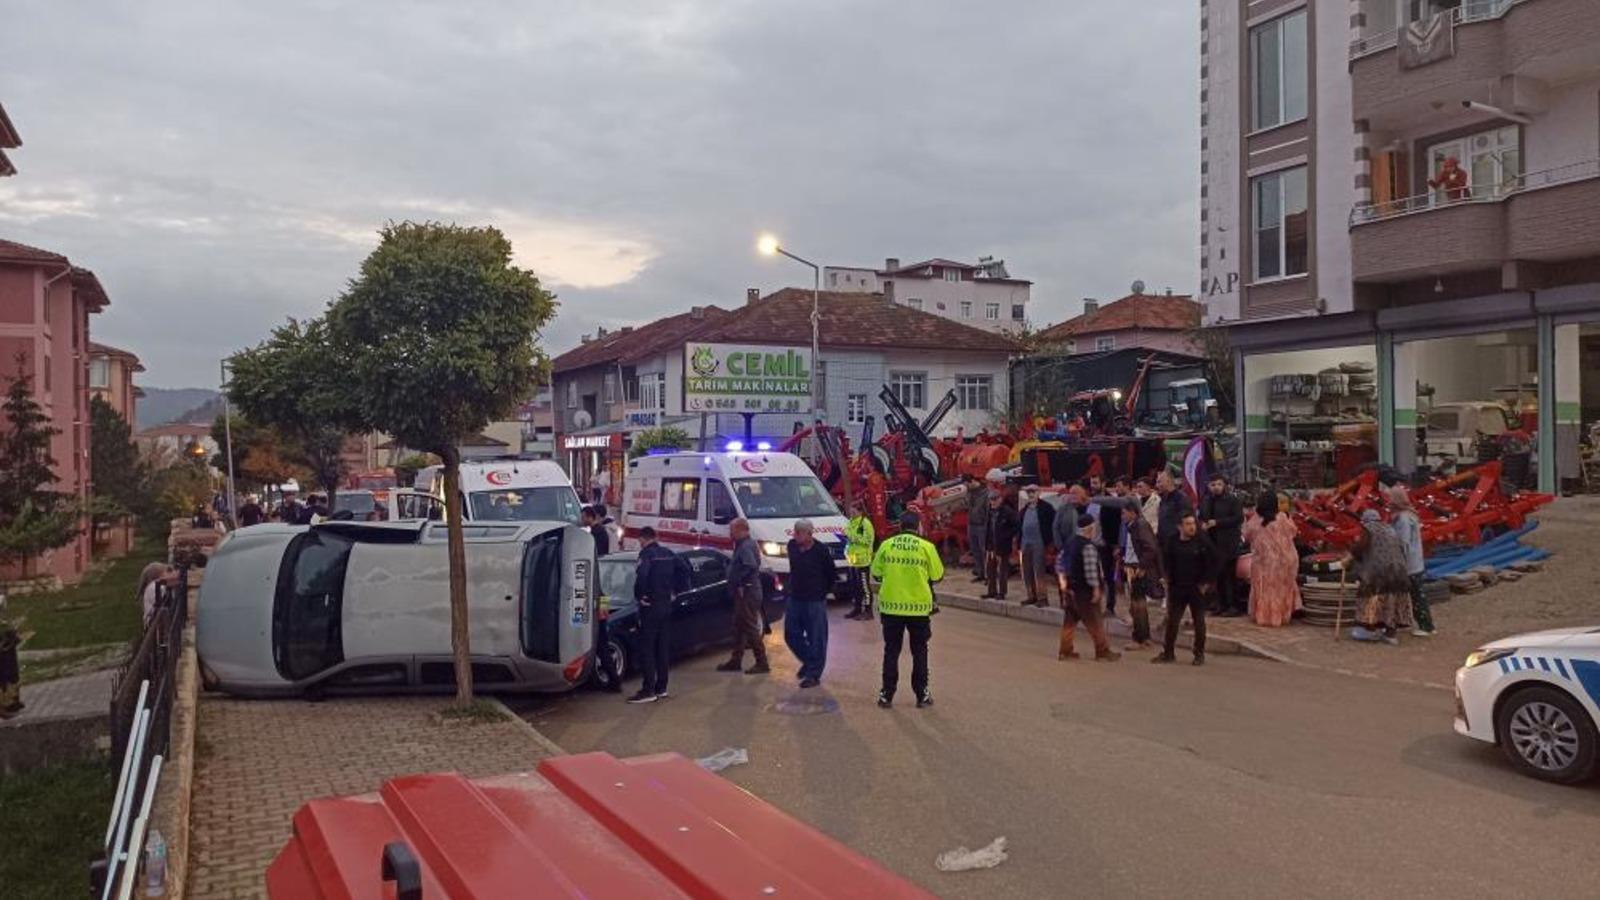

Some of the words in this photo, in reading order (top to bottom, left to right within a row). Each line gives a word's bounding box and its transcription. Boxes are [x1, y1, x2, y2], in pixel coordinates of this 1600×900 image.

[1209, 272, 1239, 296] AP
[726, 349, 809, 377] CEMİL
[688, 380, 728, 391] TARIM
[586, 435, 611, 447] MARKET
